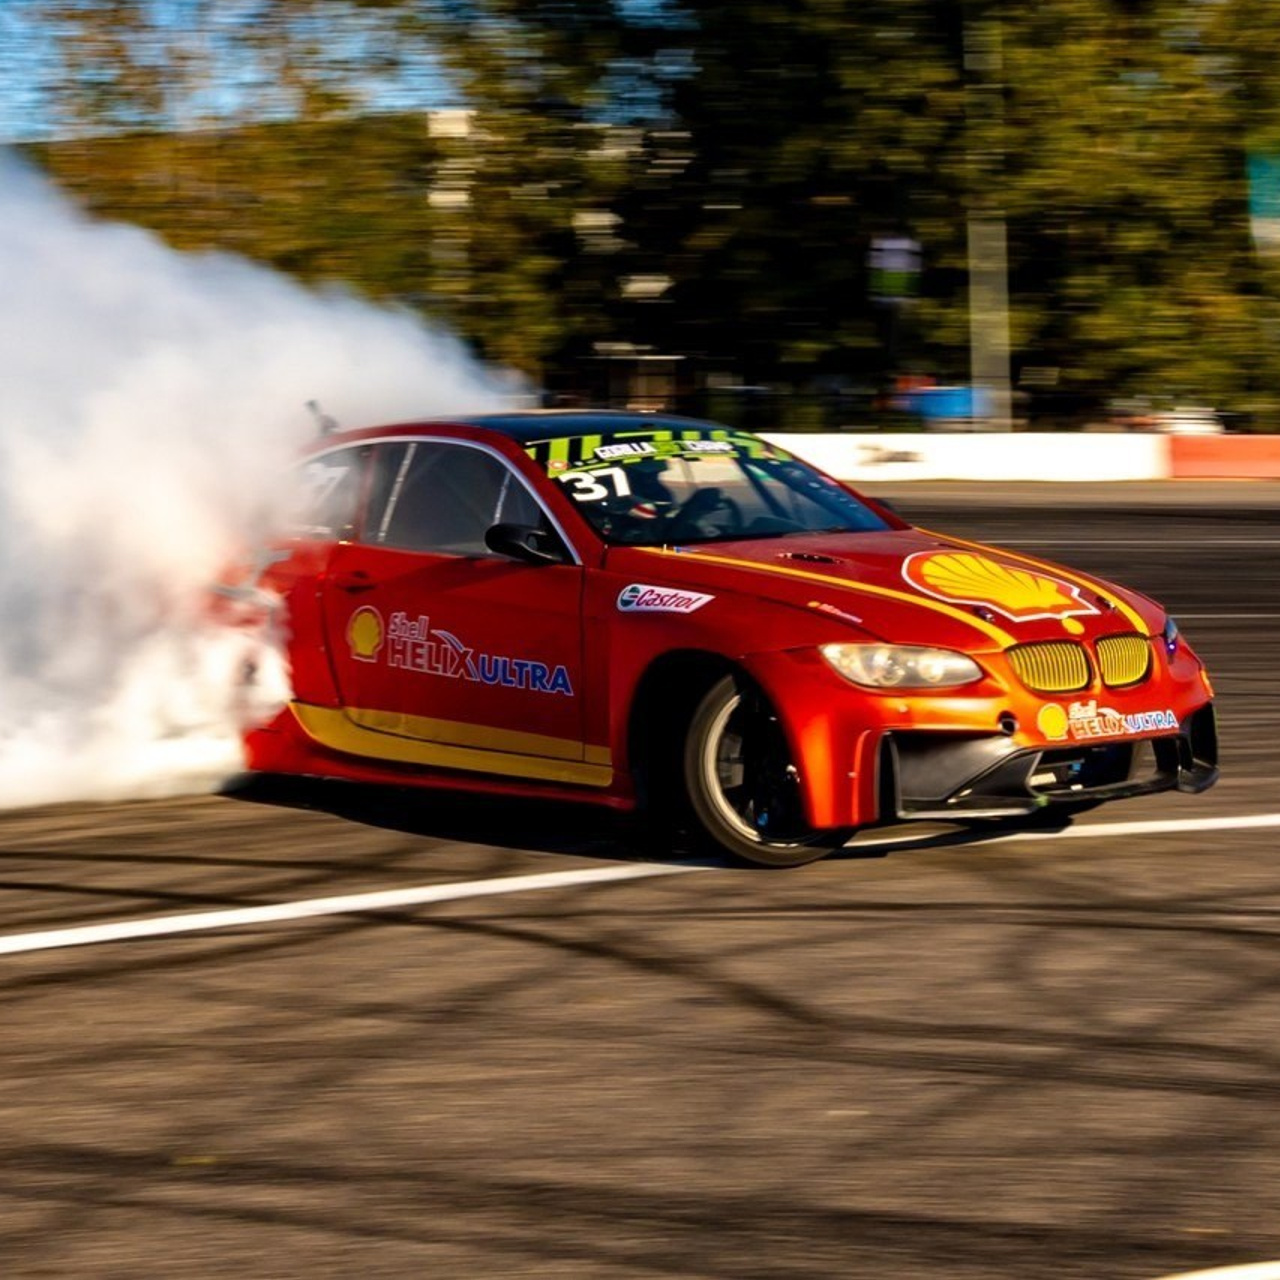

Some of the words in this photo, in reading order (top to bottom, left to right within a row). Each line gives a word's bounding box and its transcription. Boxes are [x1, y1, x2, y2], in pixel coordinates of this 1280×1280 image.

[559, 467, 631, 502] 37
[635, 588, 704, 609] Castrol
[388, 612, 430, 640] Shell
[387, 629, 480, 682] HELIX
[479, 654, 575, 696] ULTRA
[1069, 709, 1131, 739] HELIX
[1125, 709, 1180, 732] ULTRA
